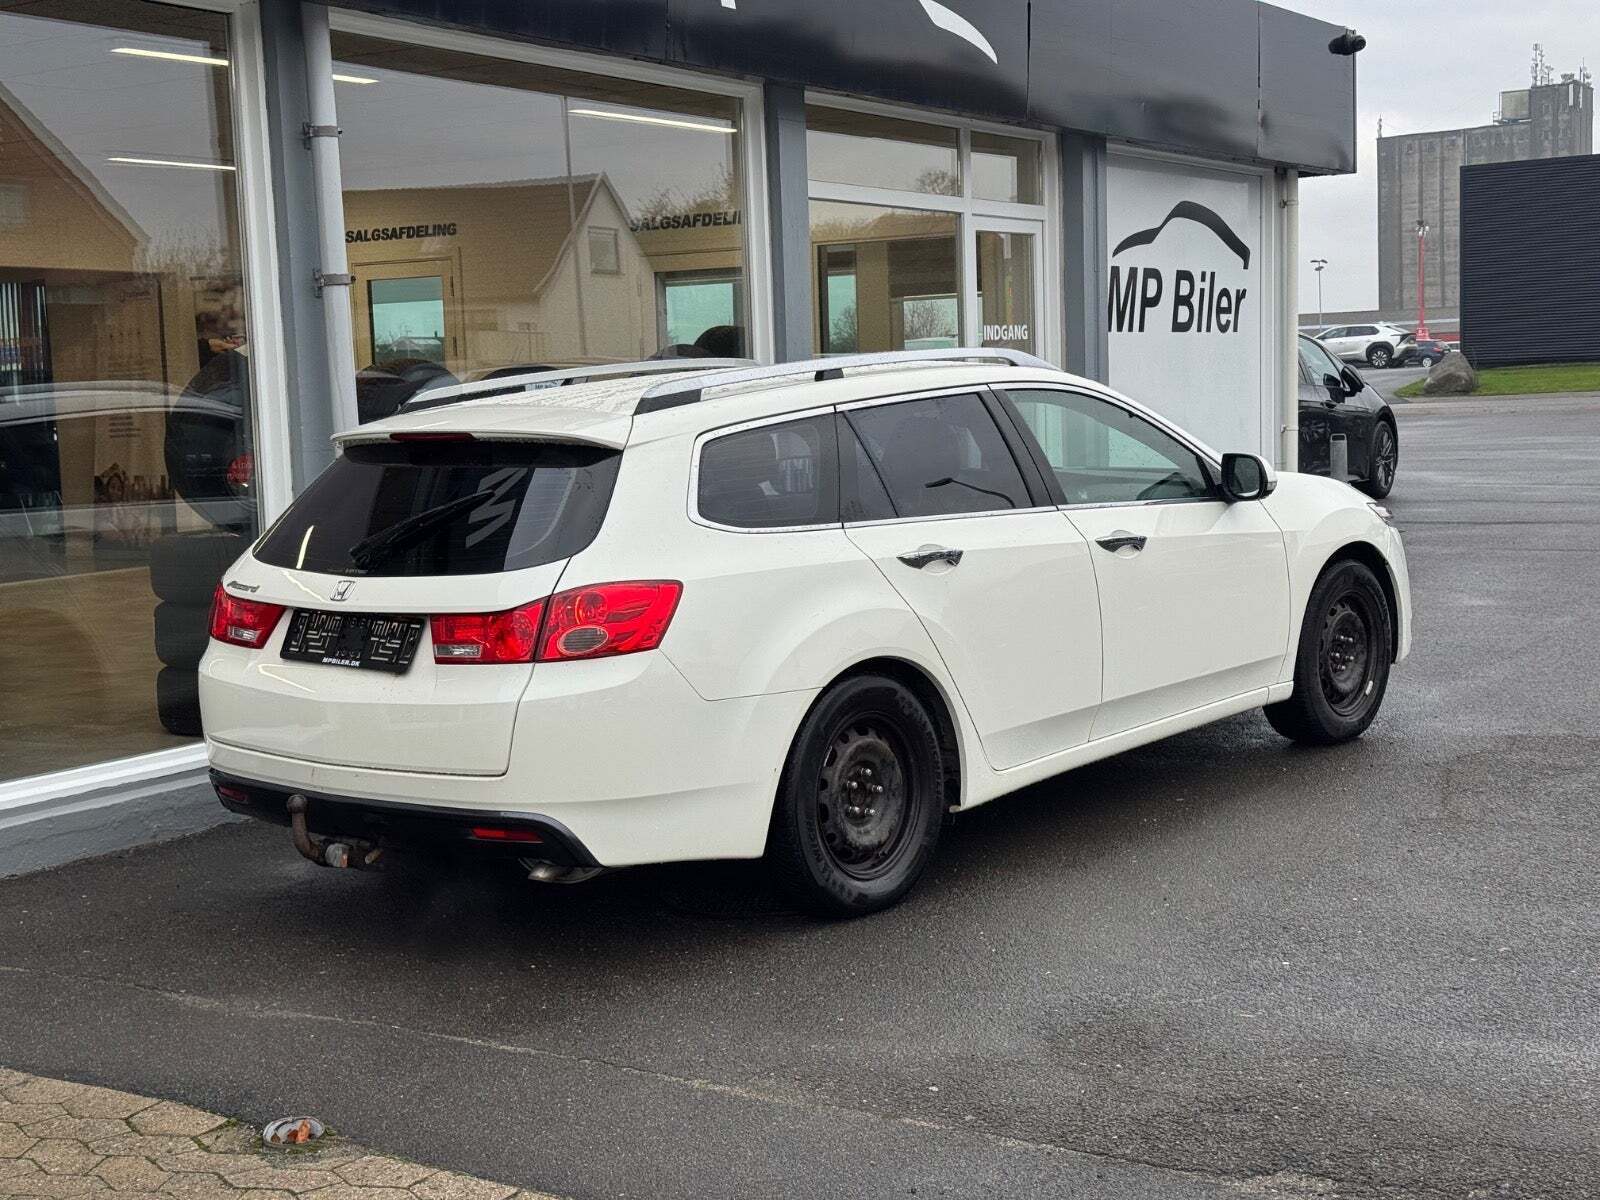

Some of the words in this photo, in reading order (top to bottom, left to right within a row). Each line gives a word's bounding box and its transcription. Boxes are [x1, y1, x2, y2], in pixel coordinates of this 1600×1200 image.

[345, 222, 457, 243] SALGSAFDELING
[1108, 265, 1163, 333] MP
[1171, 269, 1247, 334] Biler
[983, 324, 1028, 340] INDGANG
